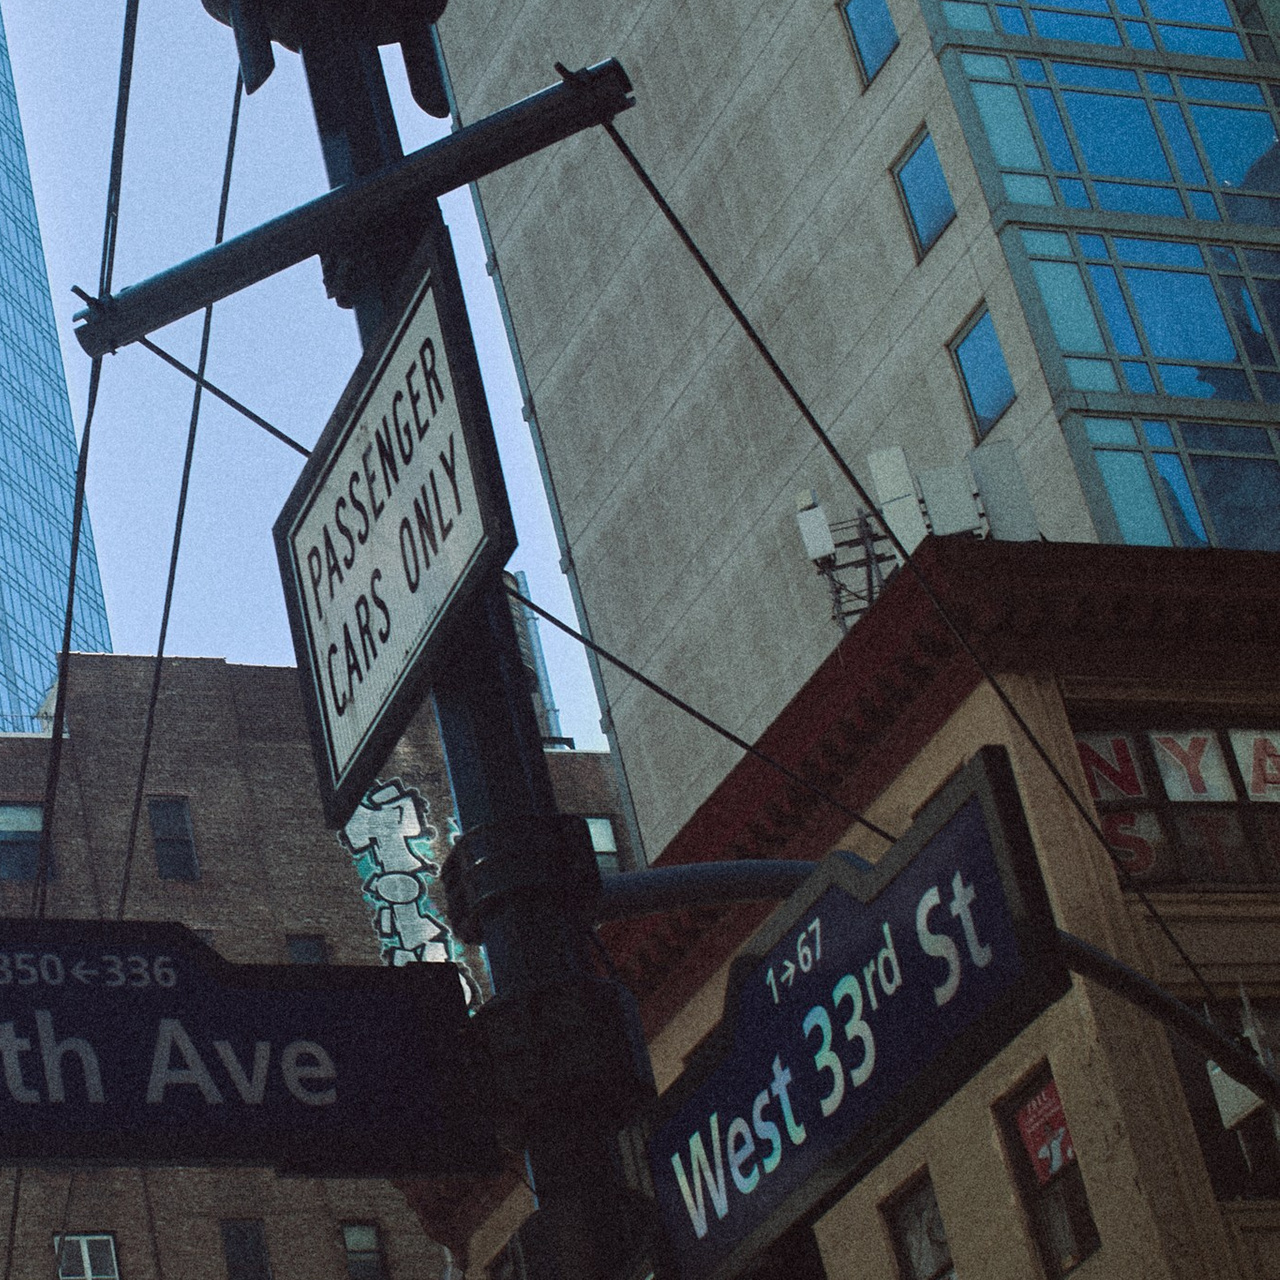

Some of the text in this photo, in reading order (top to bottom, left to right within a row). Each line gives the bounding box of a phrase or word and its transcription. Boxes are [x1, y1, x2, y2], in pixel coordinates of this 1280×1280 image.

[306, 337, 446, 620] PASSENGER
[326, 569, 392, 718] CARS
[399, 433, 463, 595] ONLY
[145, 1018, 339, 1106] Ave
[670, 868, 993, 1240] West 33rd St
